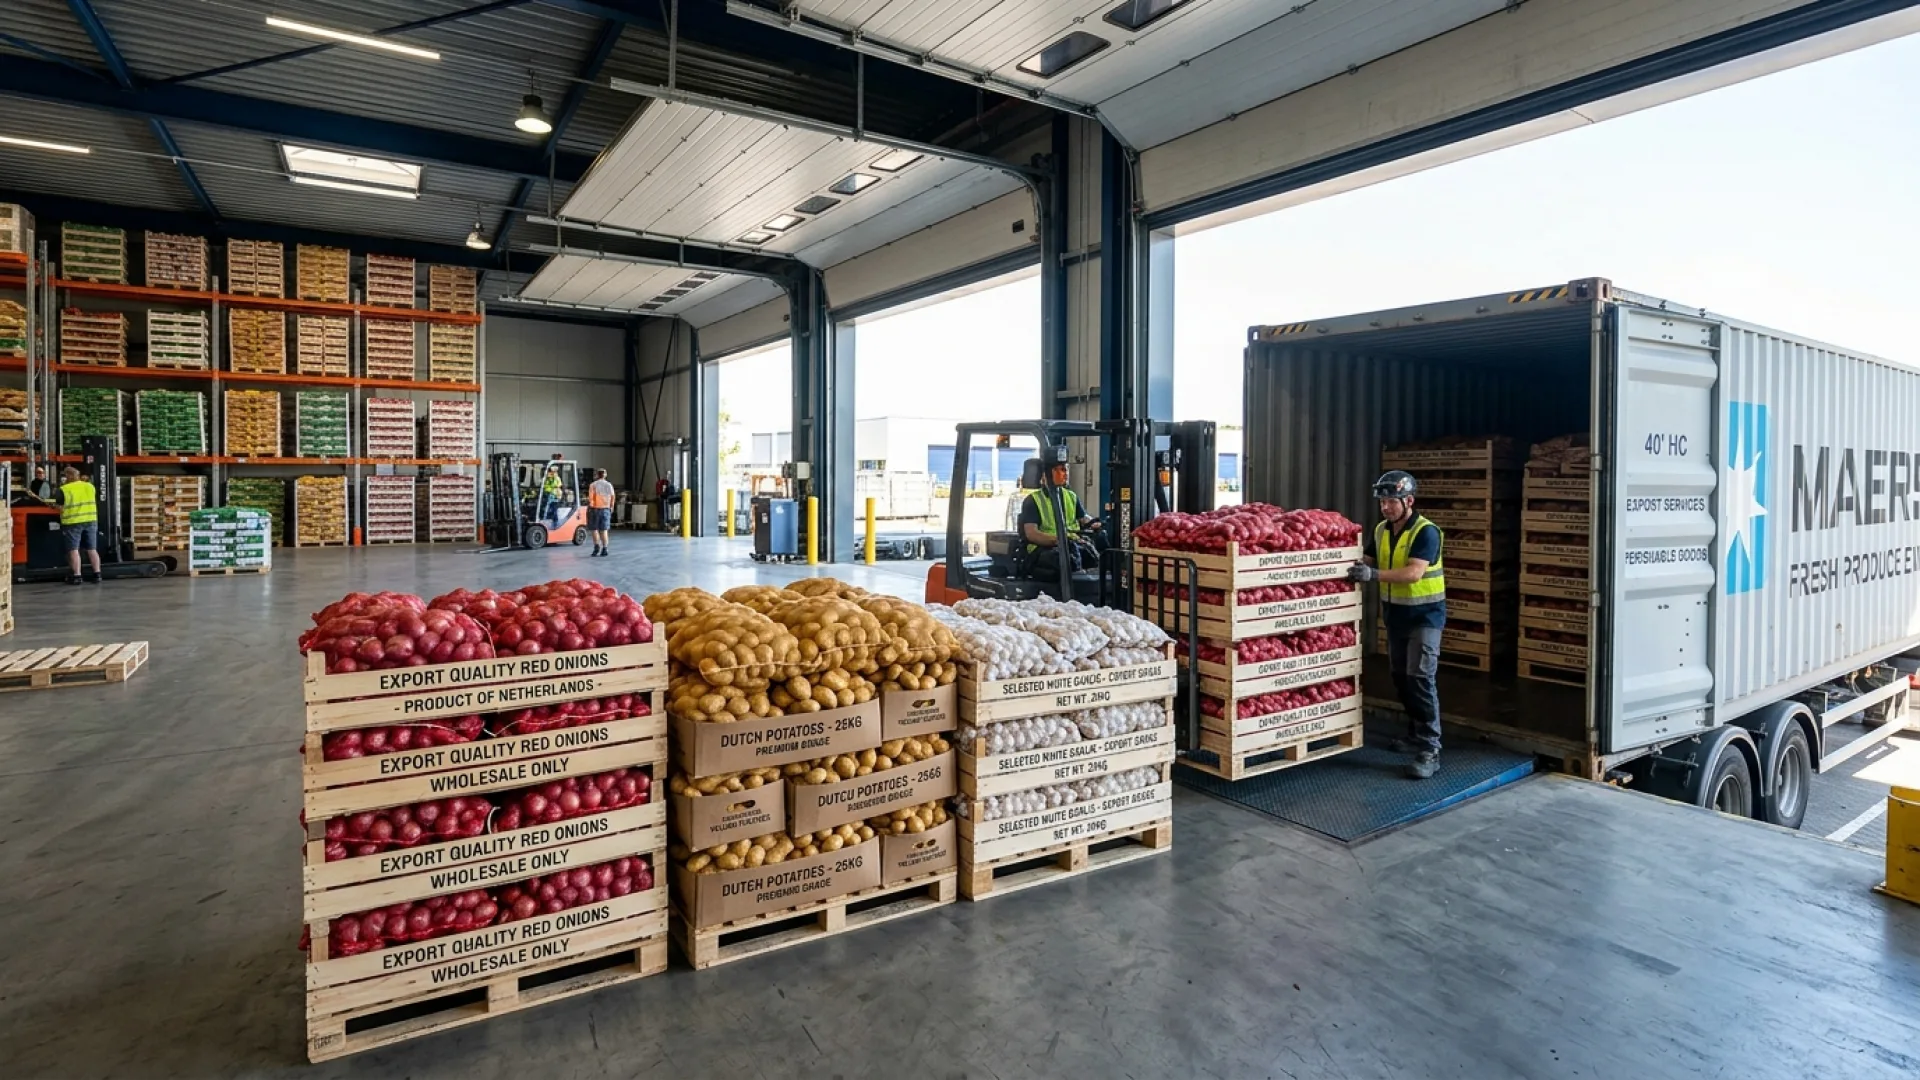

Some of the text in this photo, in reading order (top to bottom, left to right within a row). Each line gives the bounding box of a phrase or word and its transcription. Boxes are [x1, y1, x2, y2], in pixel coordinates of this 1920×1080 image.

[1668, 434, 1688, 456] HC
[1789, 557, 1838, 598] FRESH
[1844, 547, 1901, 587] PRODUCE
[380, 652, 608, 690] EXPORT QUALITY RED ONIONS
[404, 692, 473, 713] PRODUCT
[477, 690, 495, 704] OF
[380, 727, 609, 774] EXPORT QUALITY RED ONIONS
[430, 758, 569, 793] WHOLESALE ONLY
[380, 817, 609, 873] EXPORT QUALITY RED ONIONS
[430, 849, 570, 890] WHOLESALE ONLY
[382, 906, 610, 970] EXPORT QUALITY RED ONIONS
[431, 938, 570, 983] WHOLESALE ONLY
